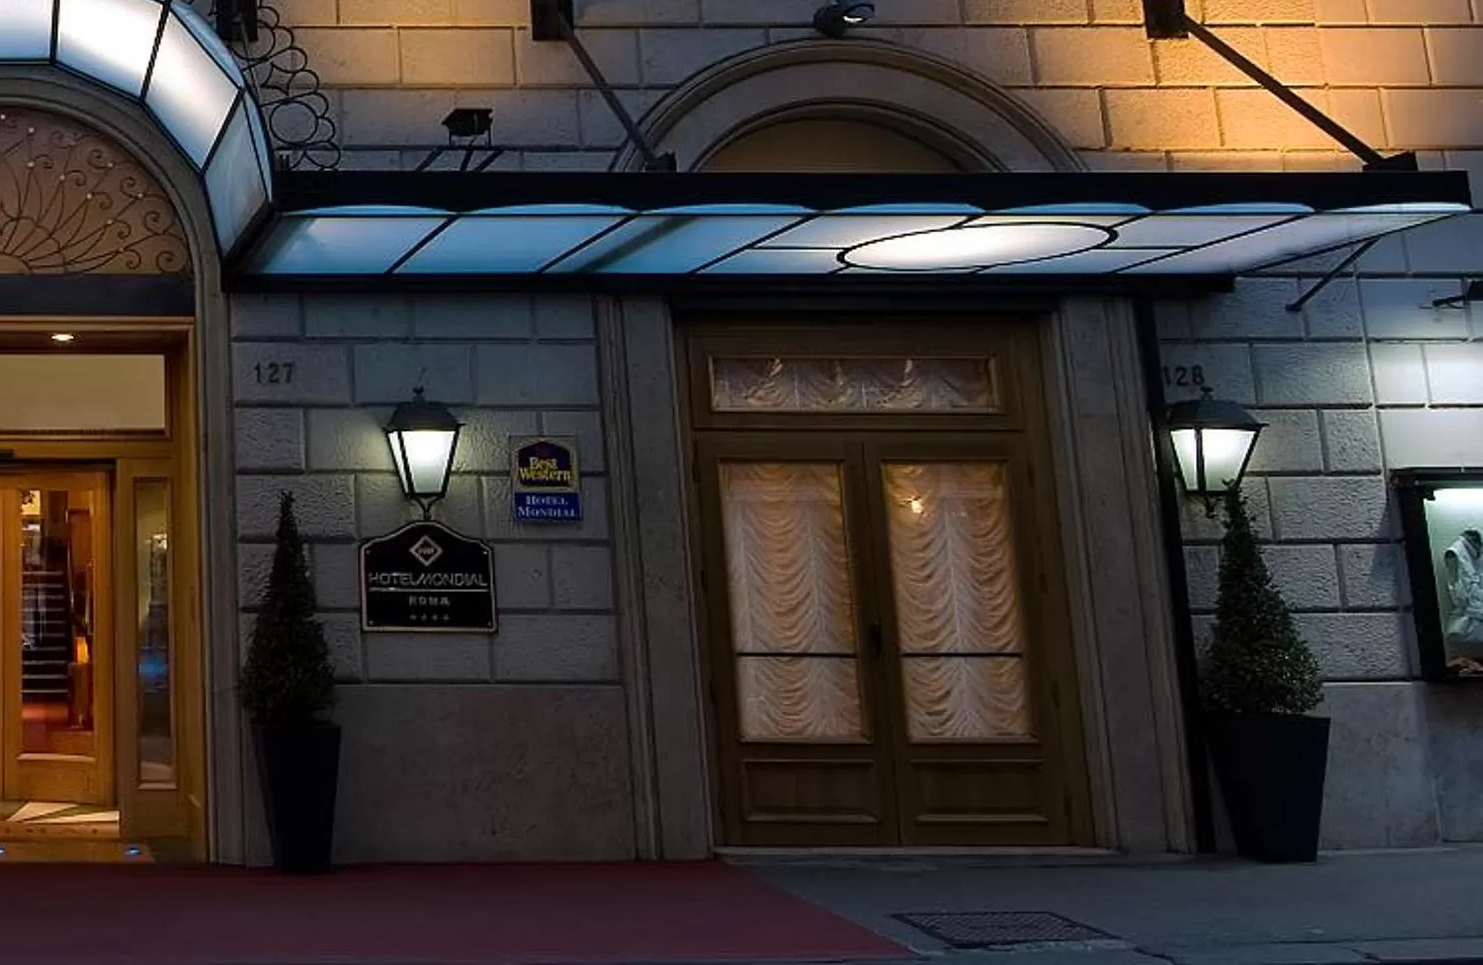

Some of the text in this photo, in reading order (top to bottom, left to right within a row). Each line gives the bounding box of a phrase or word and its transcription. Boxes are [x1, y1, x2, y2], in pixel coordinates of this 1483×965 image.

[254, 363, 295, 384] 127
[1163, 363, 1205, 386] 128
[528, 455, 559, 470] Best
[519, 465, 572, 482] Western
